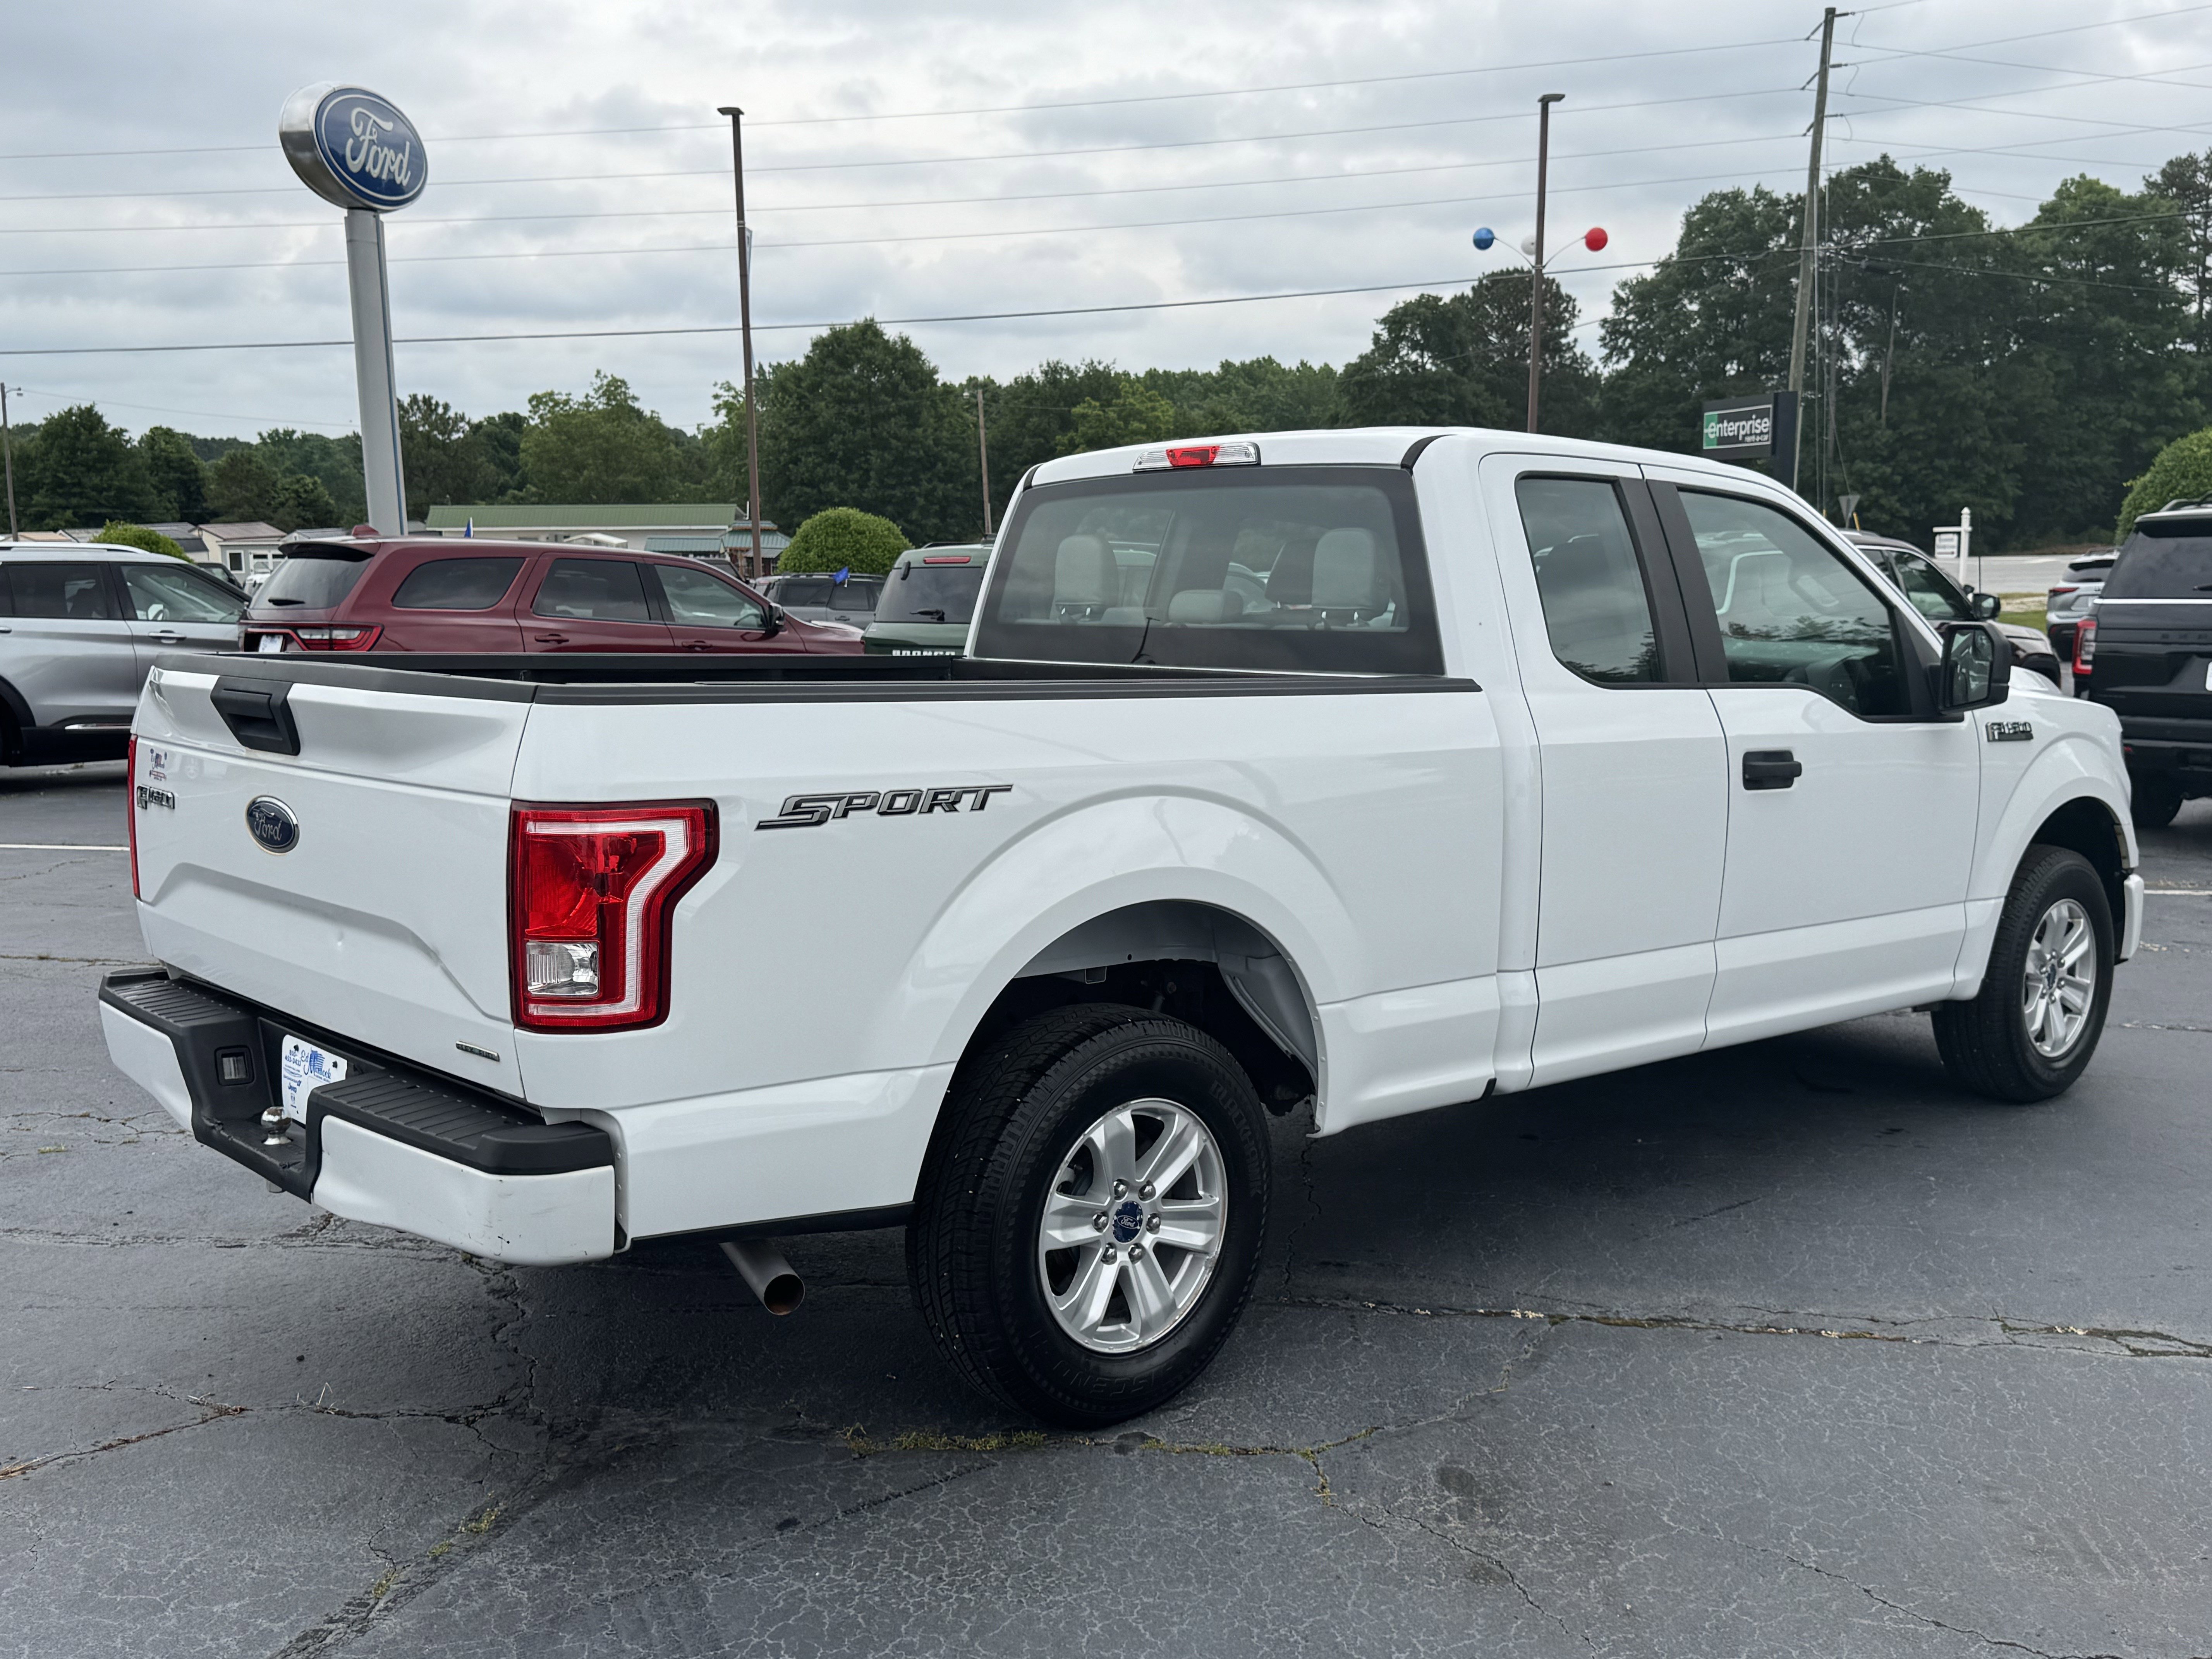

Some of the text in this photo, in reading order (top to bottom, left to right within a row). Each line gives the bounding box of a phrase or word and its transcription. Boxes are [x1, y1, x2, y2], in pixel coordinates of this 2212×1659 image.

[345, 107, 410, 187] Ford
[1708, 414, 1769, 441] enterprise
[253, 807, 282, 841] Ford
[754, 783, 1014, 831] SPORT
[1121, 1216, 1135, 1227] Ford
